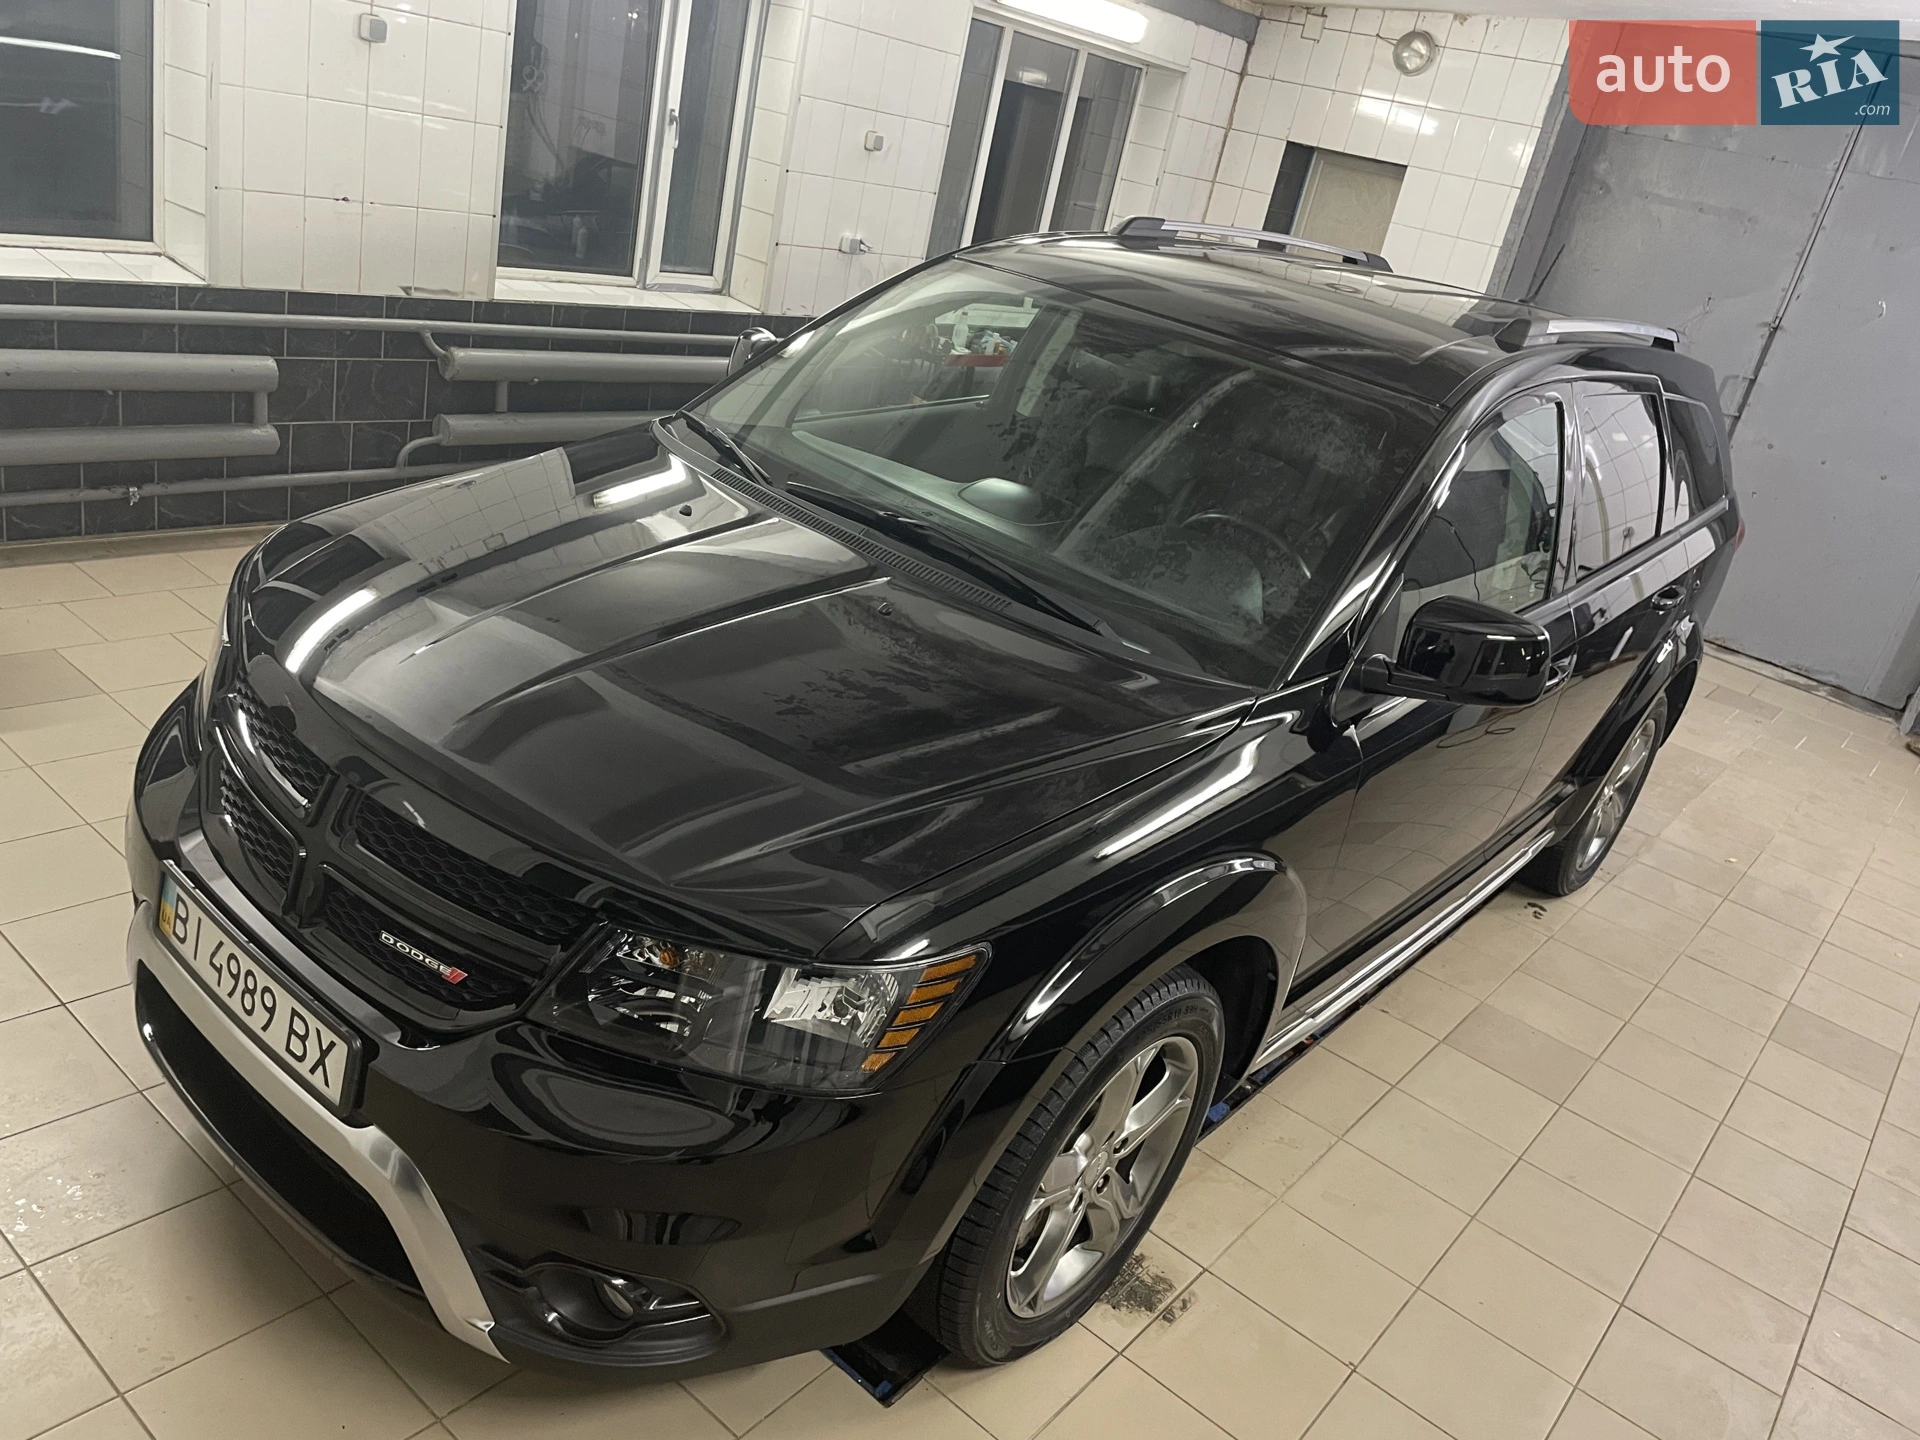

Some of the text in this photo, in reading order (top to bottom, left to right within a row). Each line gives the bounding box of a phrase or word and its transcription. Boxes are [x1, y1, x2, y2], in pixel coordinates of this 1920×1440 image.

[161, 908, 172, 929] UA
[381, 933, 452, 977] DODGE
[172, 892, 337, 1089] BI 4989 BX
